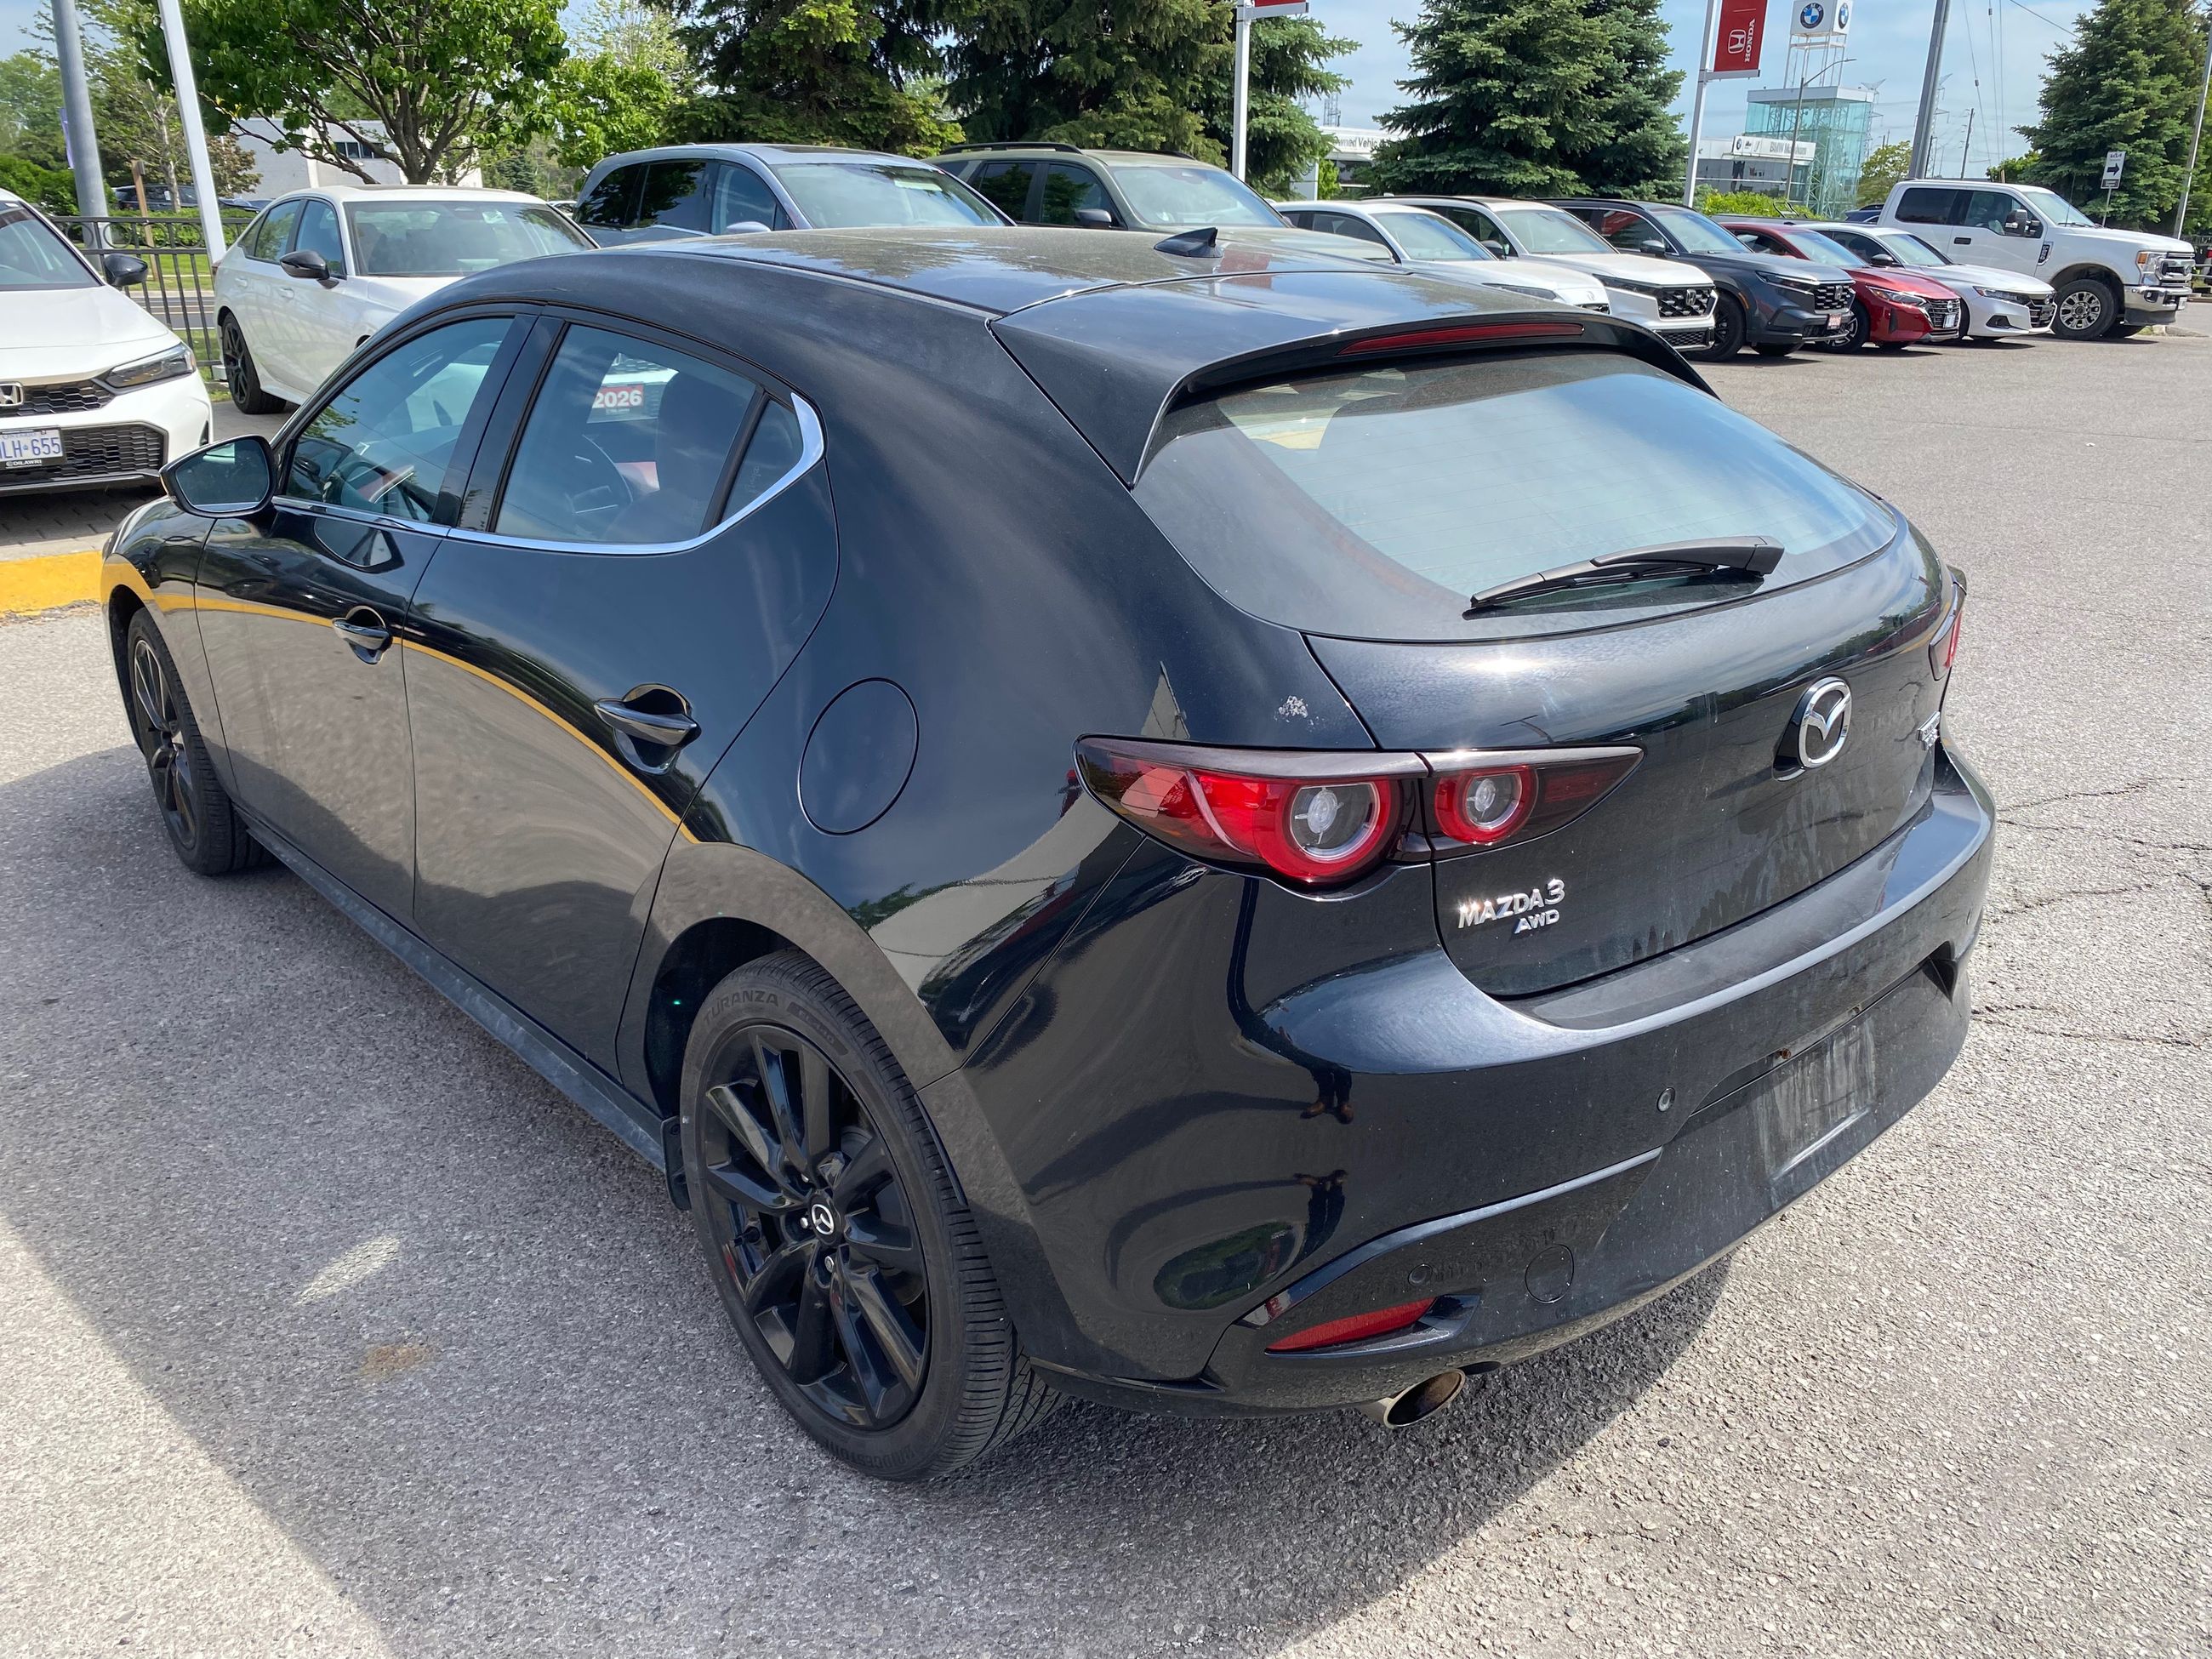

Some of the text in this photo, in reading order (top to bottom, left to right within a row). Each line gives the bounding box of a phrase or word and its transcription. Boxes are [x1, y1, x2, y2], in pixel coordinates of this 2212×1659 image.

[1745, 19, 1755, 62] HONDA
[592, 390, 642, 408] 2026
[1514, 909, 1559, 934] AWD
[703, 989, 778, 1025] TURANZA
